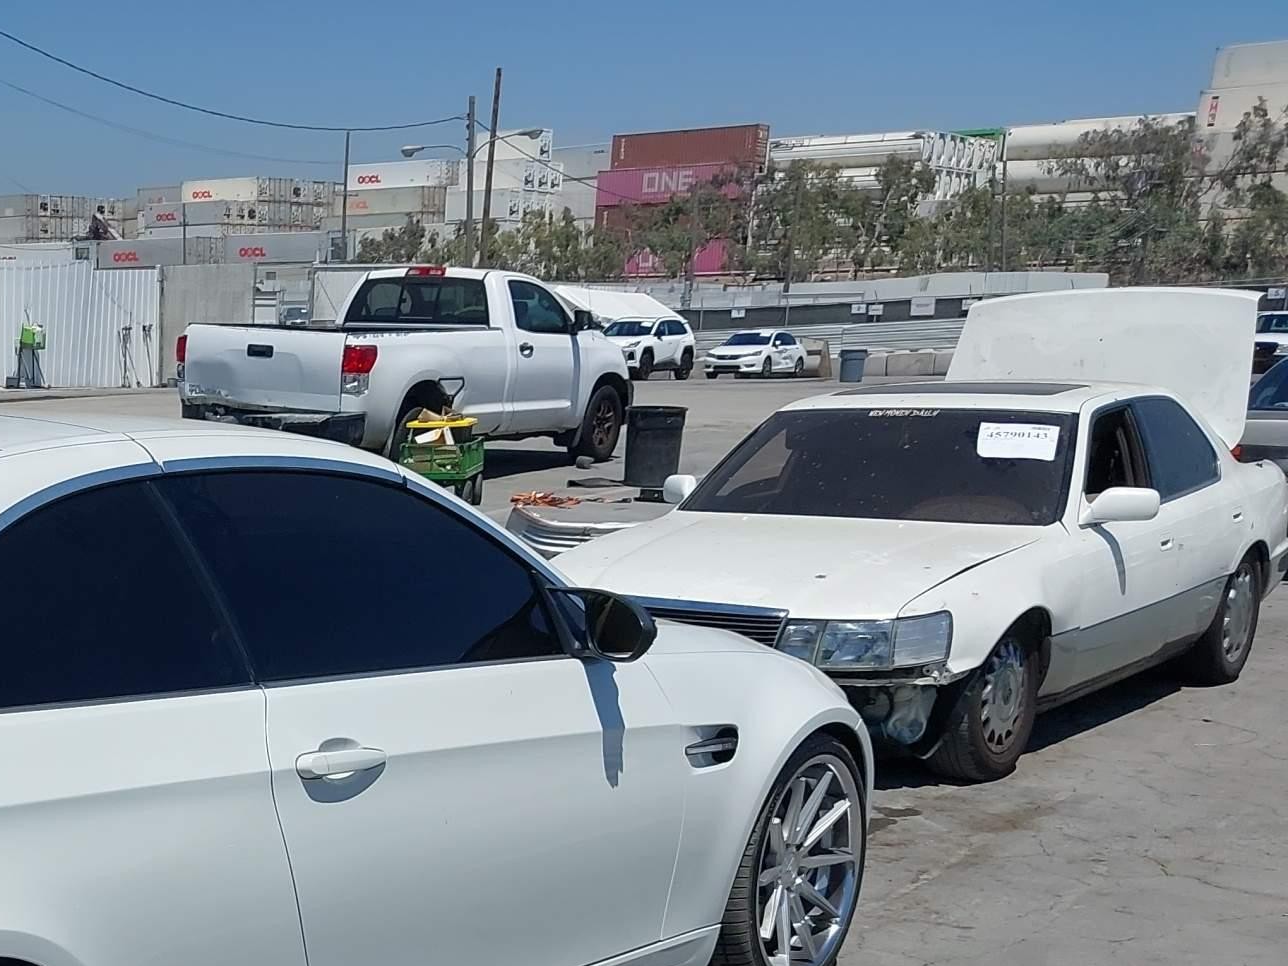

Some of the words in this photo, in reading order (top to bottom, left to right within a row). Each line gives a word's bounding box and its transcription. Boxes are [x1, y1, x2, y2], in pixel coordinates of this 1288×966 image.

[358, 175, 381, 184] OOCL
[642, 171, 693, 193] ONE
[192, 191, 212, 199] OOCL
[156, 212, 176, 221] OOCL
[113, 252, 139, 262] OOCL
[239, 248, 266, 258] OOCL
[986, 431, 1048, 440] 45790143
